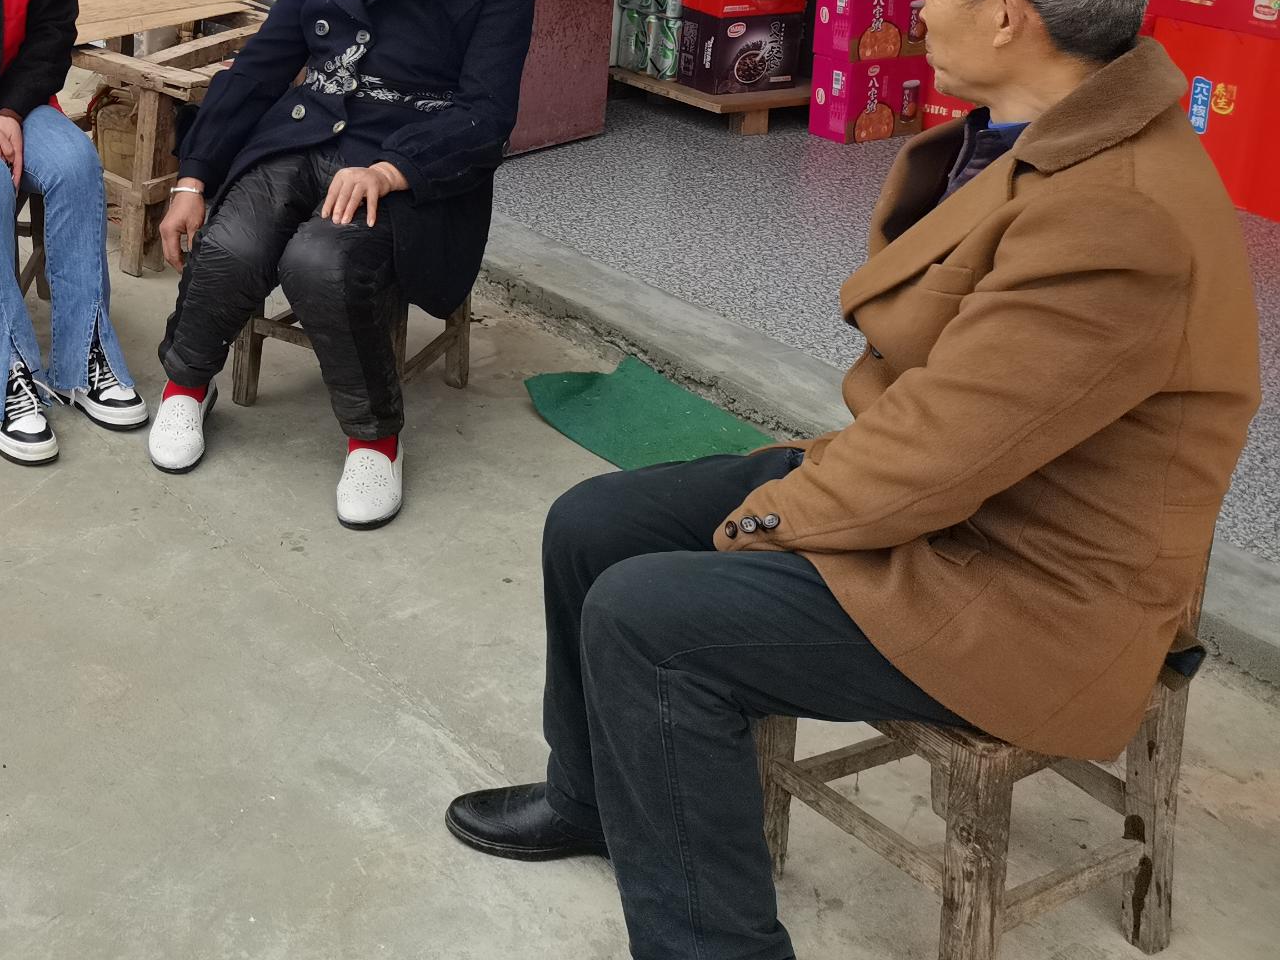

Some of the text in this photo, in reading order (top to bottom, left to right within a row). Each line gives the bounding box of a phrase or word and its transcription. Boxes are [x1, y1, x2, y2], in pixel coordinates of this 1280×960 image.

[864, 77, 880, 114] 八宝粥
[1189, 81, 1211, 129] 六个核桃
